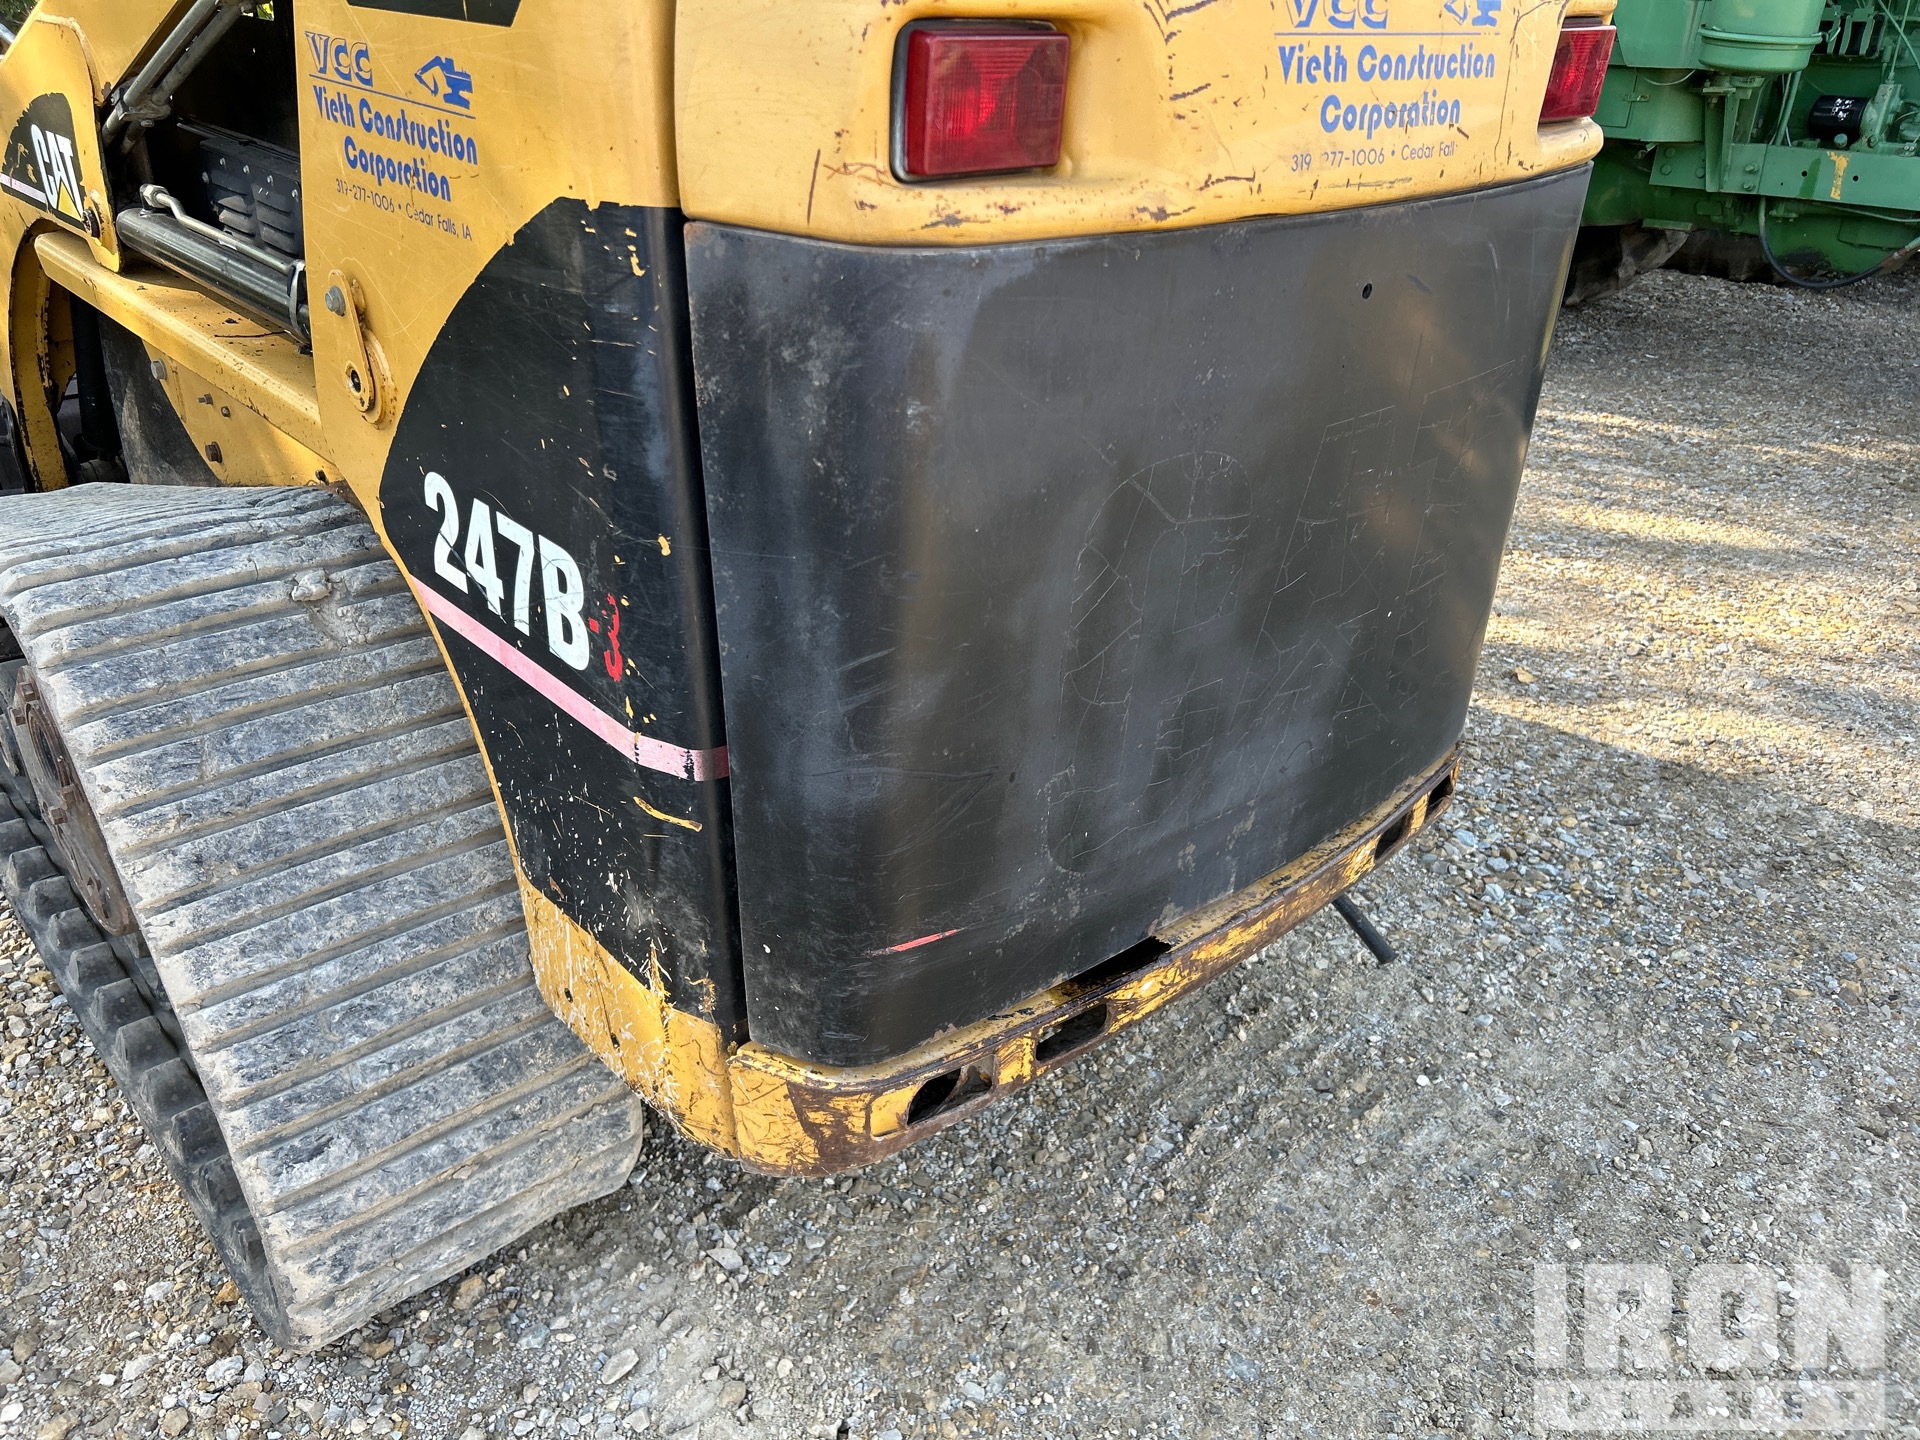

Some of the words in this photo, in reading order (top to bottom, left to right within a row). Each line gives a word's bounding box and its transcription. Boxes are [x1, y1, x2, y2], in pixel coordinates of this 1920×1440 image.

[305, 31, 373, 87] VCC
[1278, 43, 1348, 84] Vieth
[1357, 43, 1495, 82] Construction
[313, 85, 356, 128] Vieth
[359, 97, 478, 165] Construction
[1320, 89, 1460, 139] Corporation
[31, 123, 84, 221] CAT
[344, 135, 451, 202] Corporation
[1401, 144, 1434, 161] Cedar
[1439, 141, 1459, 157] Fall
[406, 202, 434, 226] Cedar
[437, 214, 459, 238] Falls,
[462, 223, 473, 241] IA
